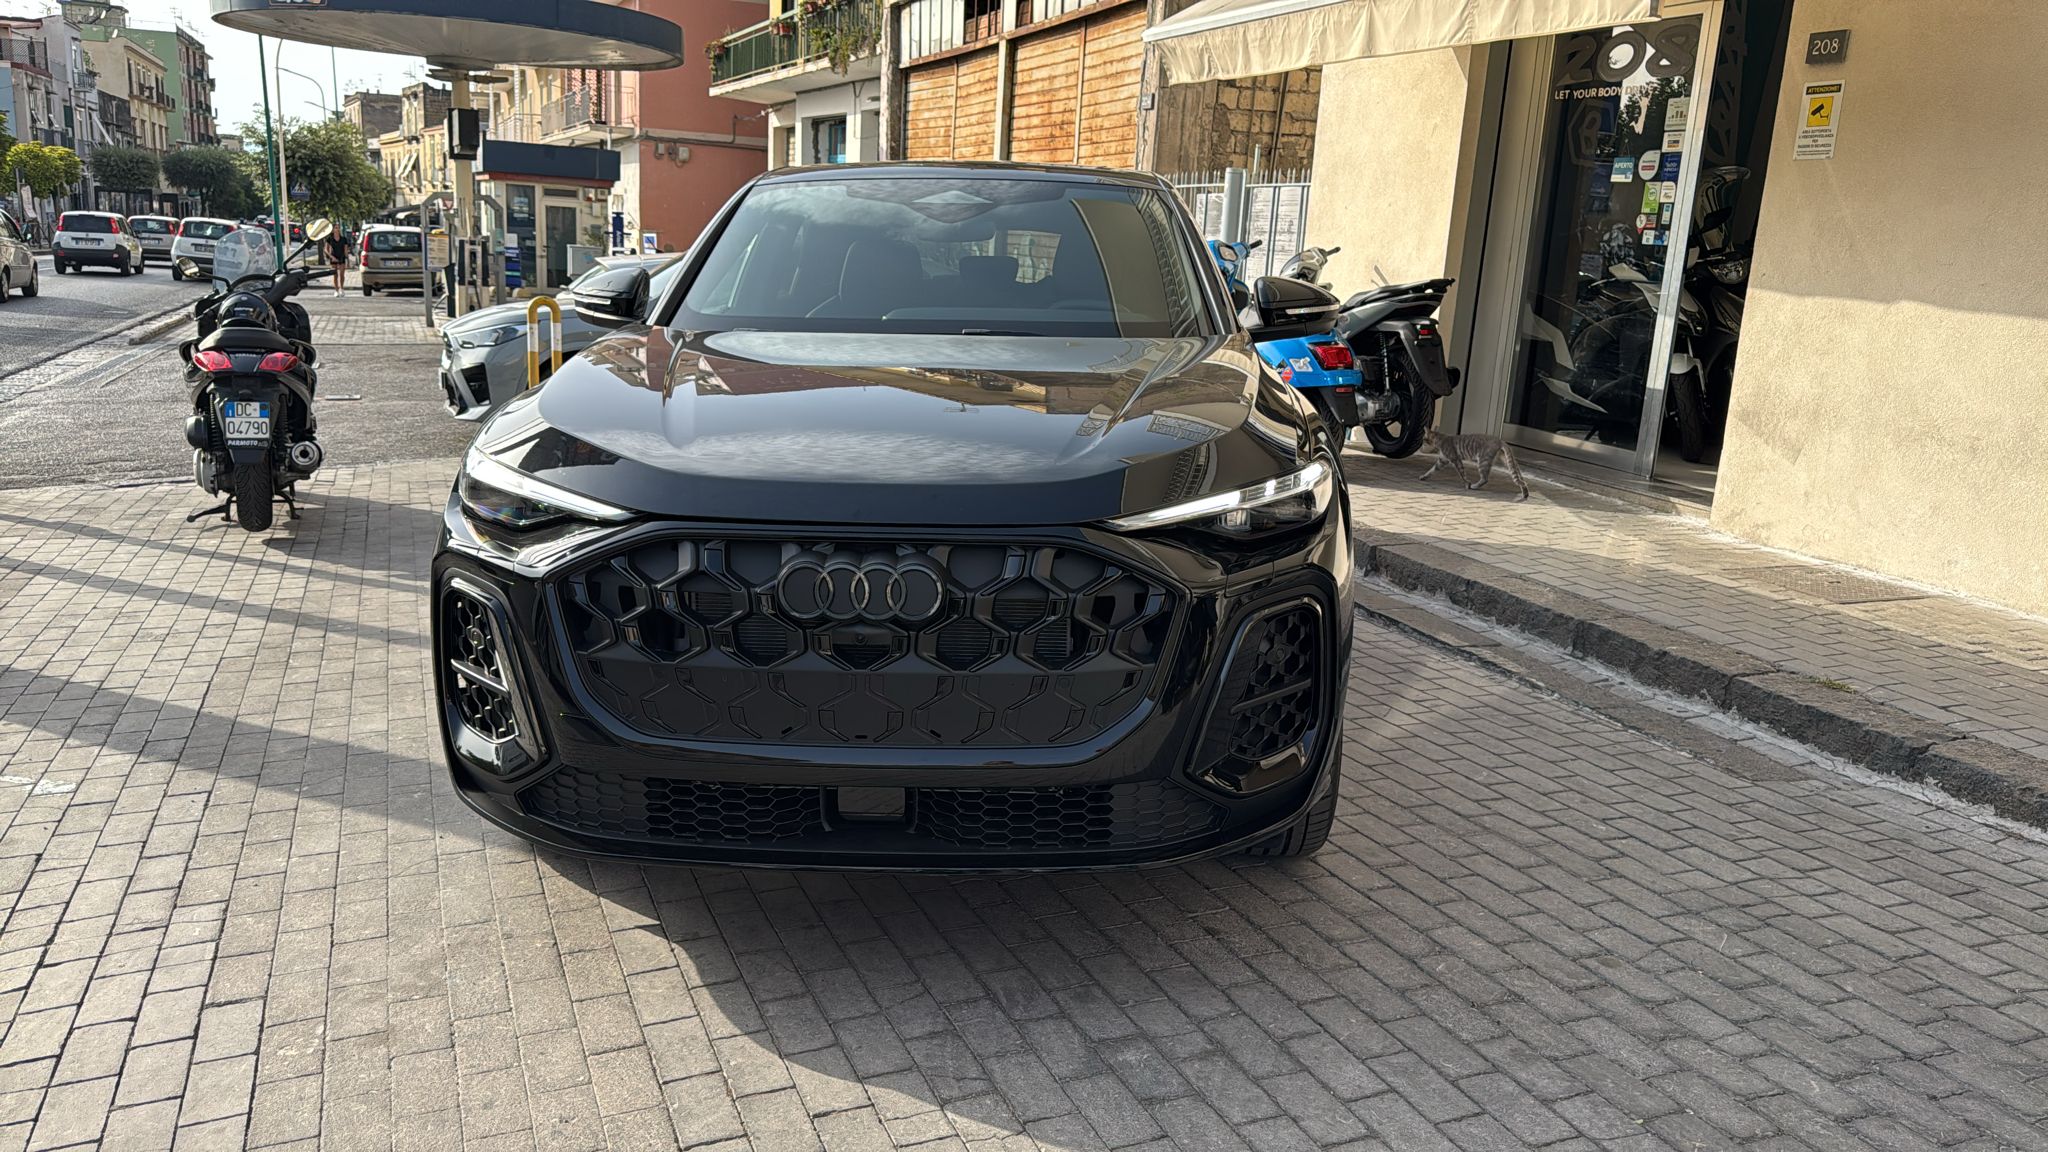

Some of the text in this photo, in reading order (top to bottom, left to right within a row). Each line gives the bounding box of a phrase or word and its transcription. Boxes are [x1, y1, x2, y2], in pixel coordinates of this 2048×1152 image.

[1812, 38, 1839, 55] 208
[1554, 84, 1655, 100] LET YOUR BODY DRIVE
[236, 403, 252, 417] DC
[227, 421, 268, 435] 04790
